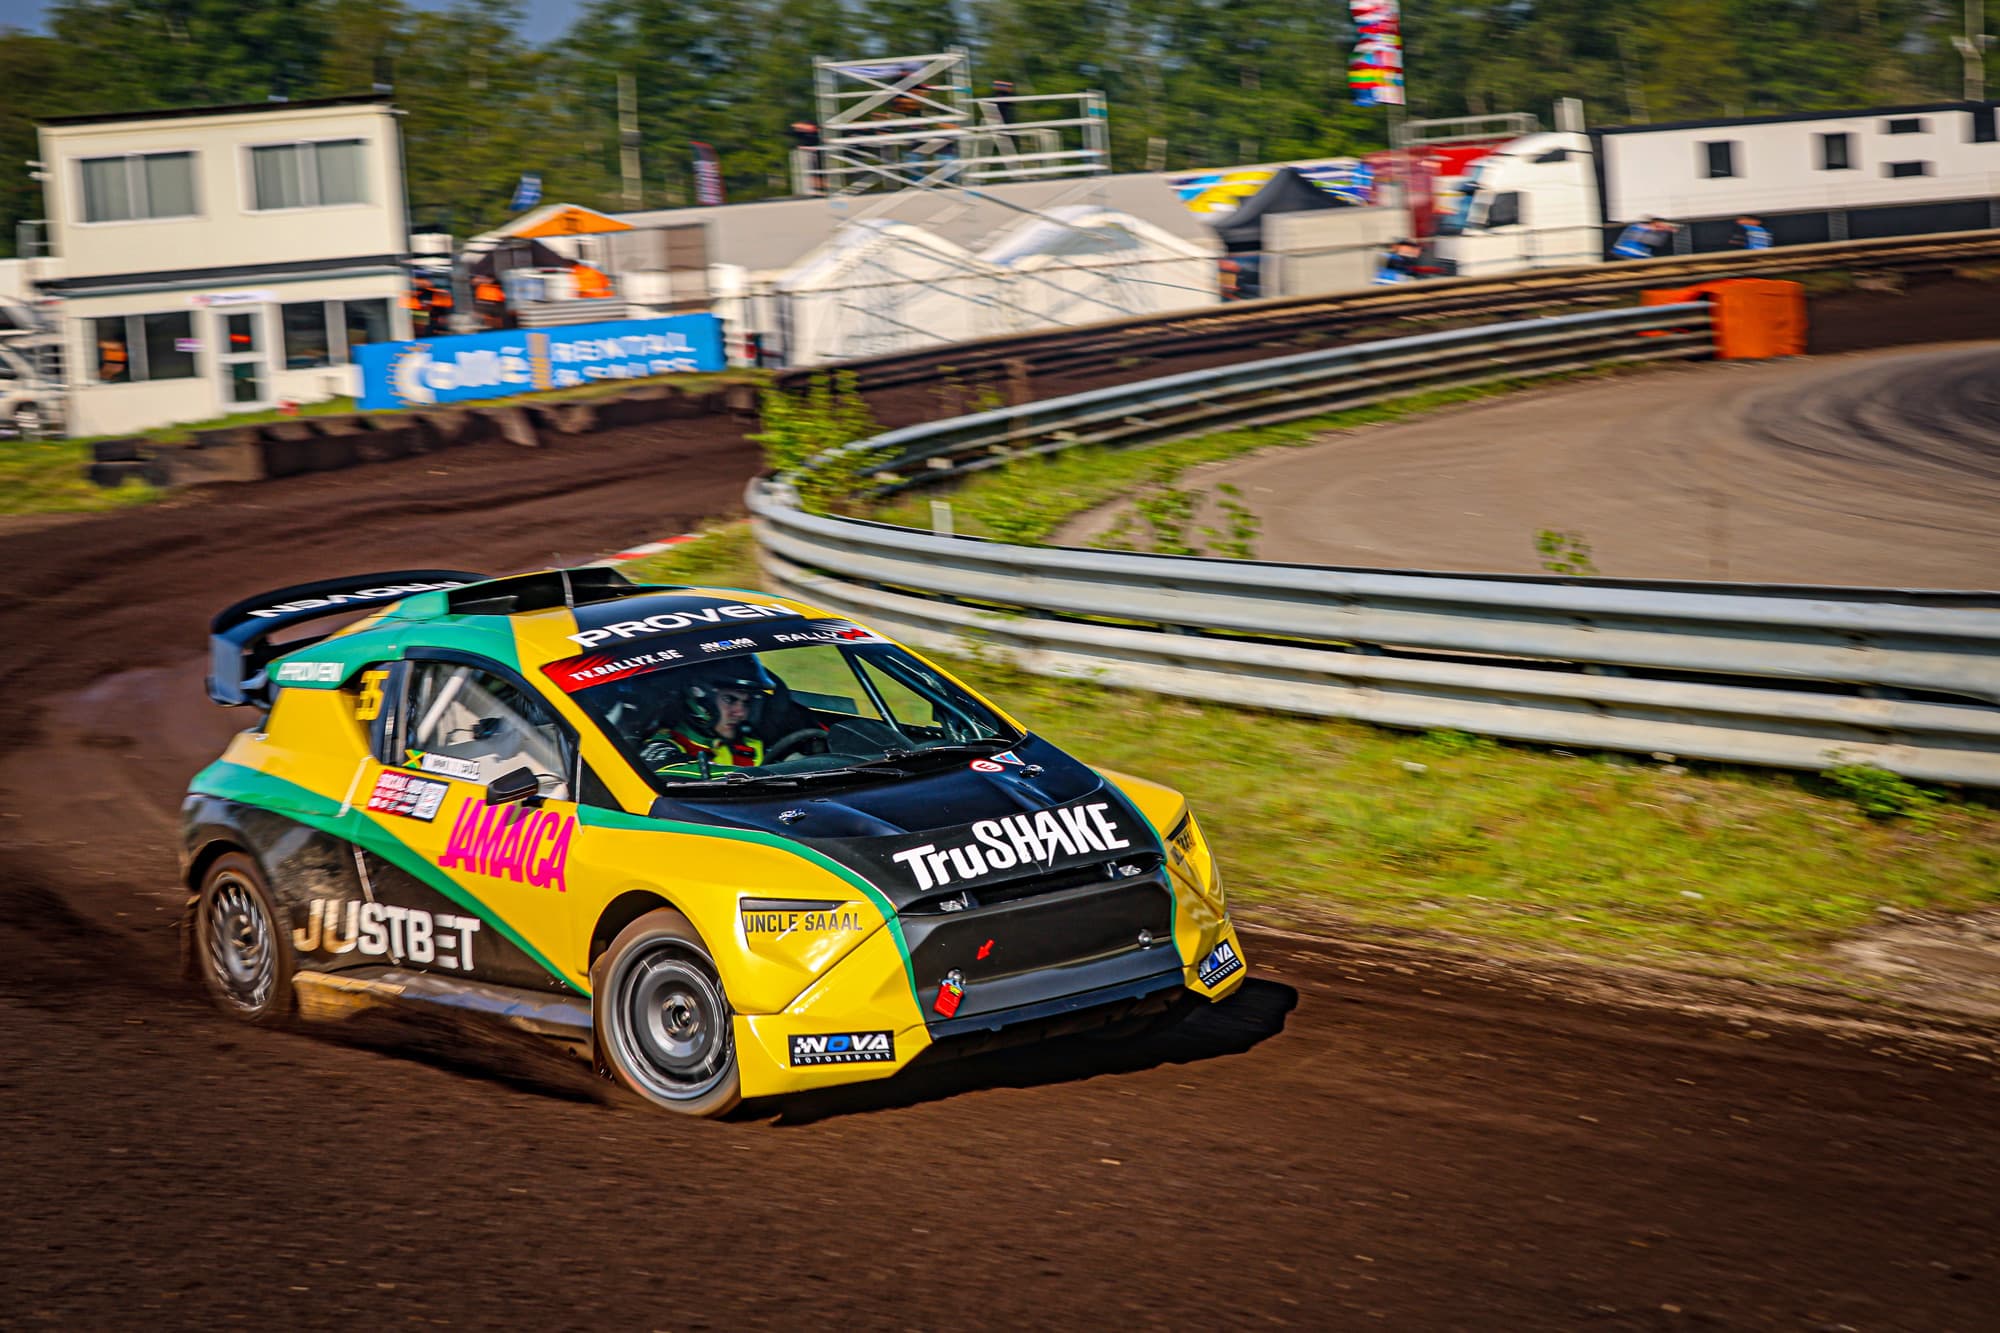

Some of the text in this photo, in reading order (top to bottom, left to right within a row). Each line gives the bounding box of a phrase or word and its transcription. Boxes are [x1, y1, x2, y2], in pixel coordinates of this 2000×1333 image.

[568, 603, 797, 648] PROVEN
[568, 650, 684, 681] TV.RALLYX.SE
[438, 797, 576, 892] JAMAICA
[892, 802, 1130, 891] TruSHAKE
[292, 899, 480, 971] JUSTBET
[744, 913, 863, 933] UNCLE SAAAL
[794, 1053, 890, 1065] MOTORSPORT
